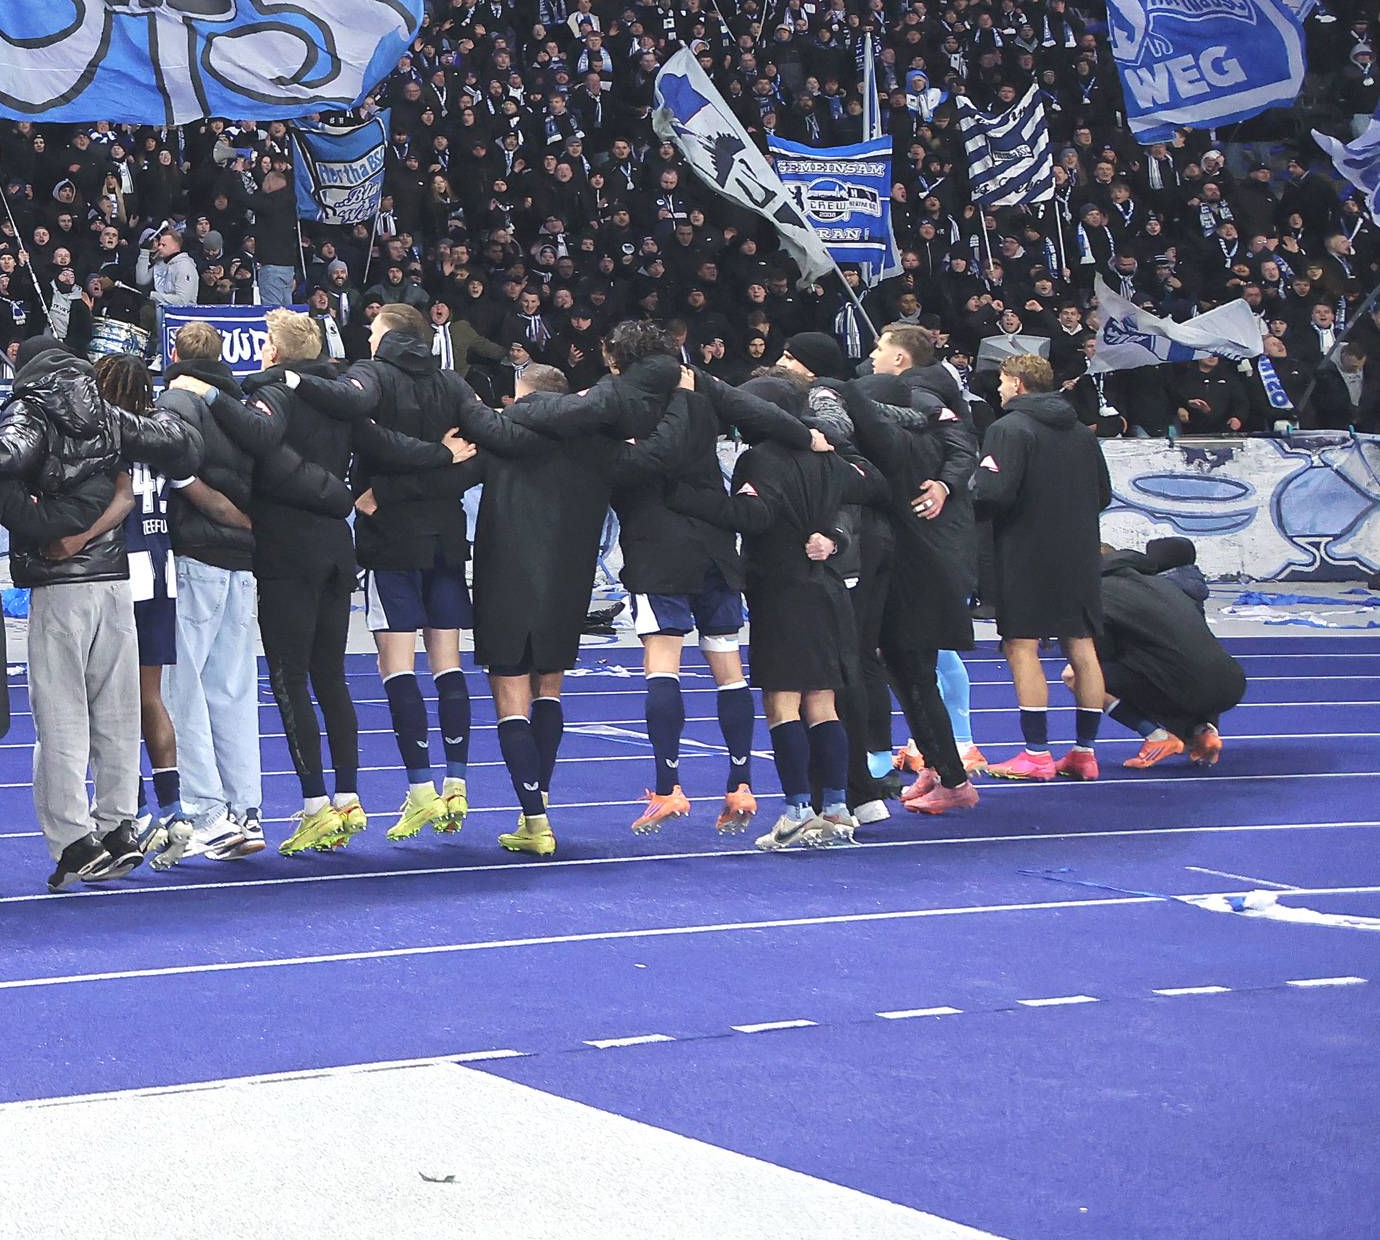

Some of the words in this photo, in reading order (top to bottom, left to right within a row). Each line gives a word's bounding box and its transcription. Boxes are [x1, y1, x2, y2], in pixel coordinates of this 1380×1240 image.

[1124, 45, 1248, 109] WEG
[319, 161, 367, 185] Hertha
[777, 160, 885, 176] GEMEINSAM
[810, 200, 846, 210] CREW
[818, 228, 862, 241] RAN
